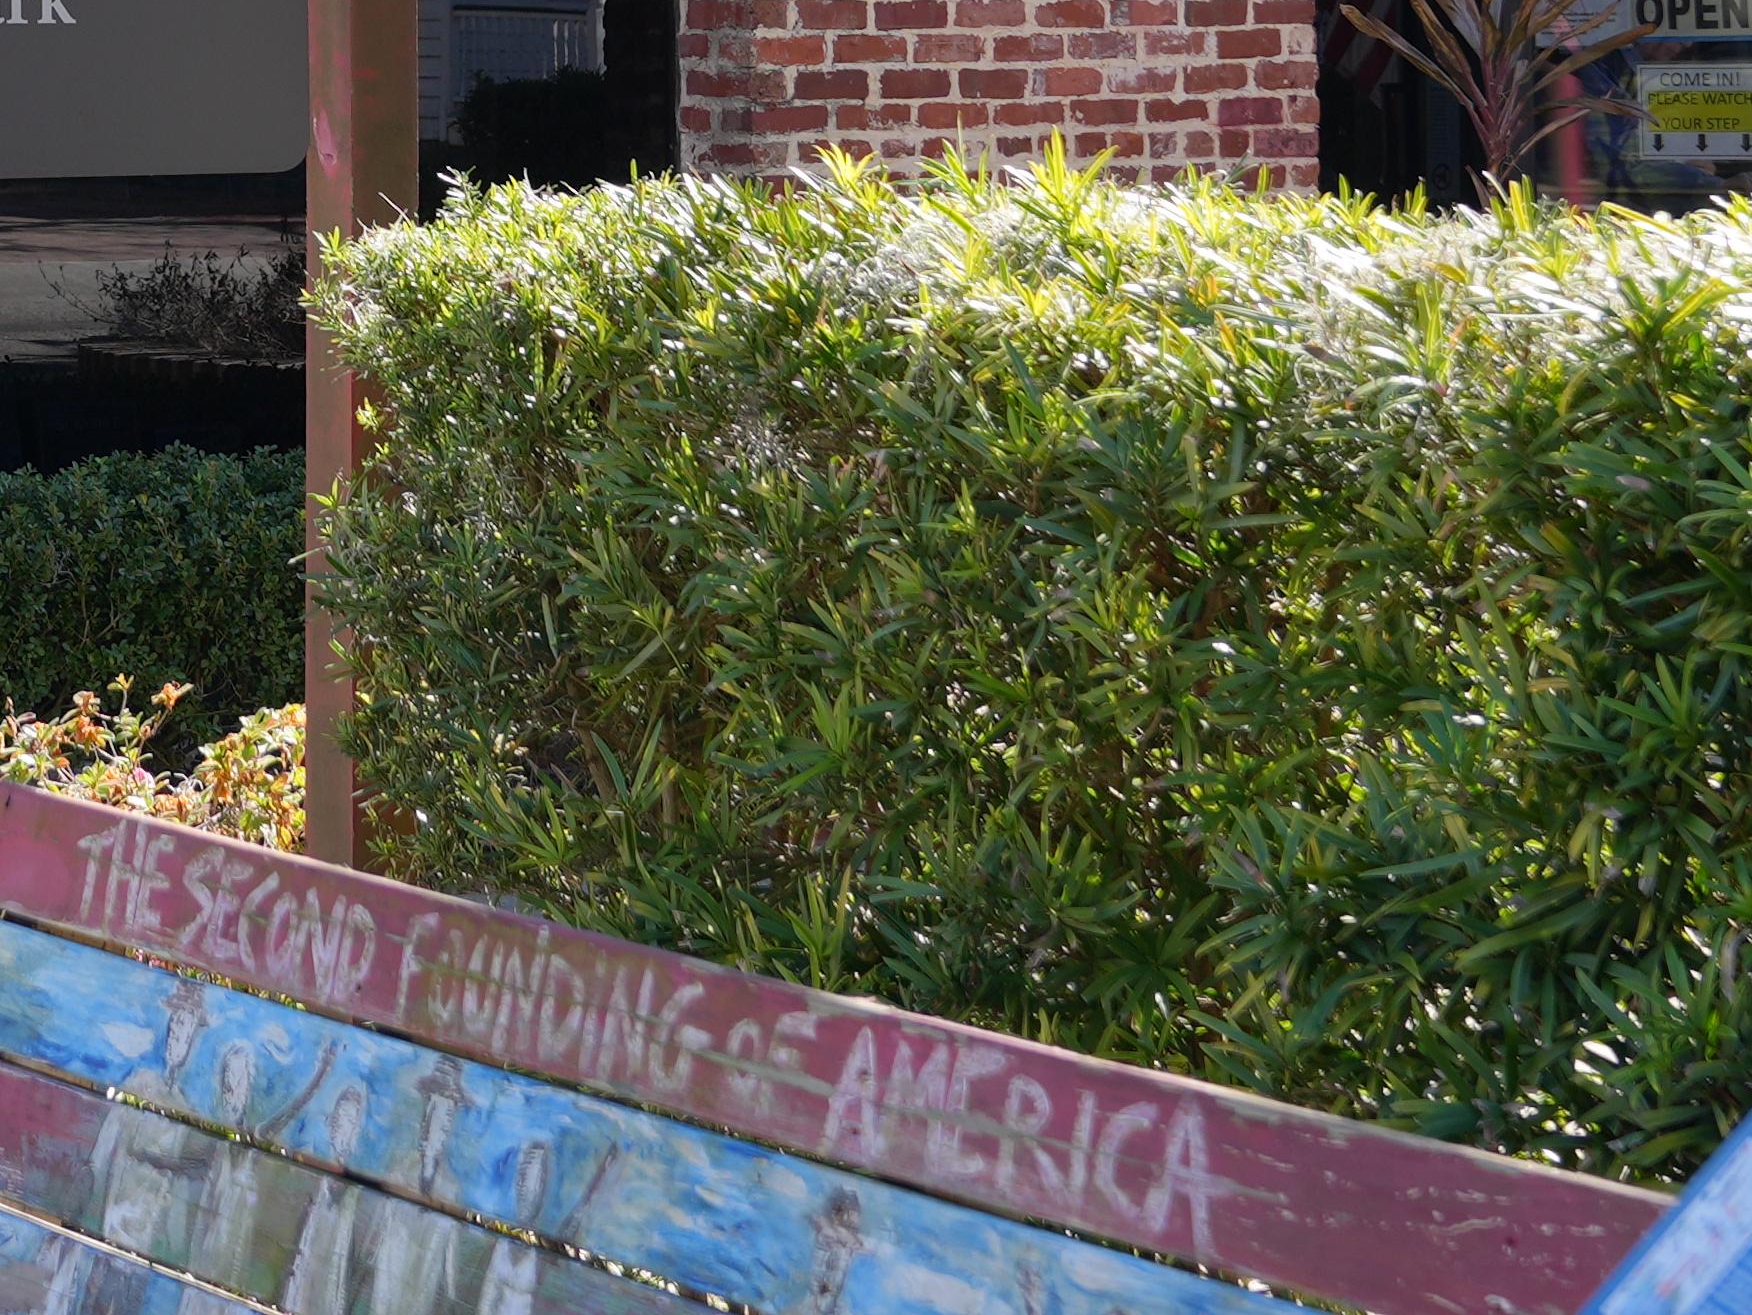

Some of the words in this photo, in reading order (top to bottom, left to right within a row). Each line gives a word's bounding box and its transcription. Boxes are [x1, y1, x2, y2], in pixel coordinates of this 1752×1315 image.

[1659, 71, 1710, 87] COME
[1716, 72, 1741, 87] IN!
[1647, 92, 1698, 105] PLEASE
[1661, 118, 1701, 130] YOUR
[1706, 118, 1741, 130] STEP
[77, 817, 175, 937] THE
[182, 846, 376, 1006] SECOND
[395, 911, 713, 1091] FOUNDING
[821, 1025, 1230, 1259] AMERICA
